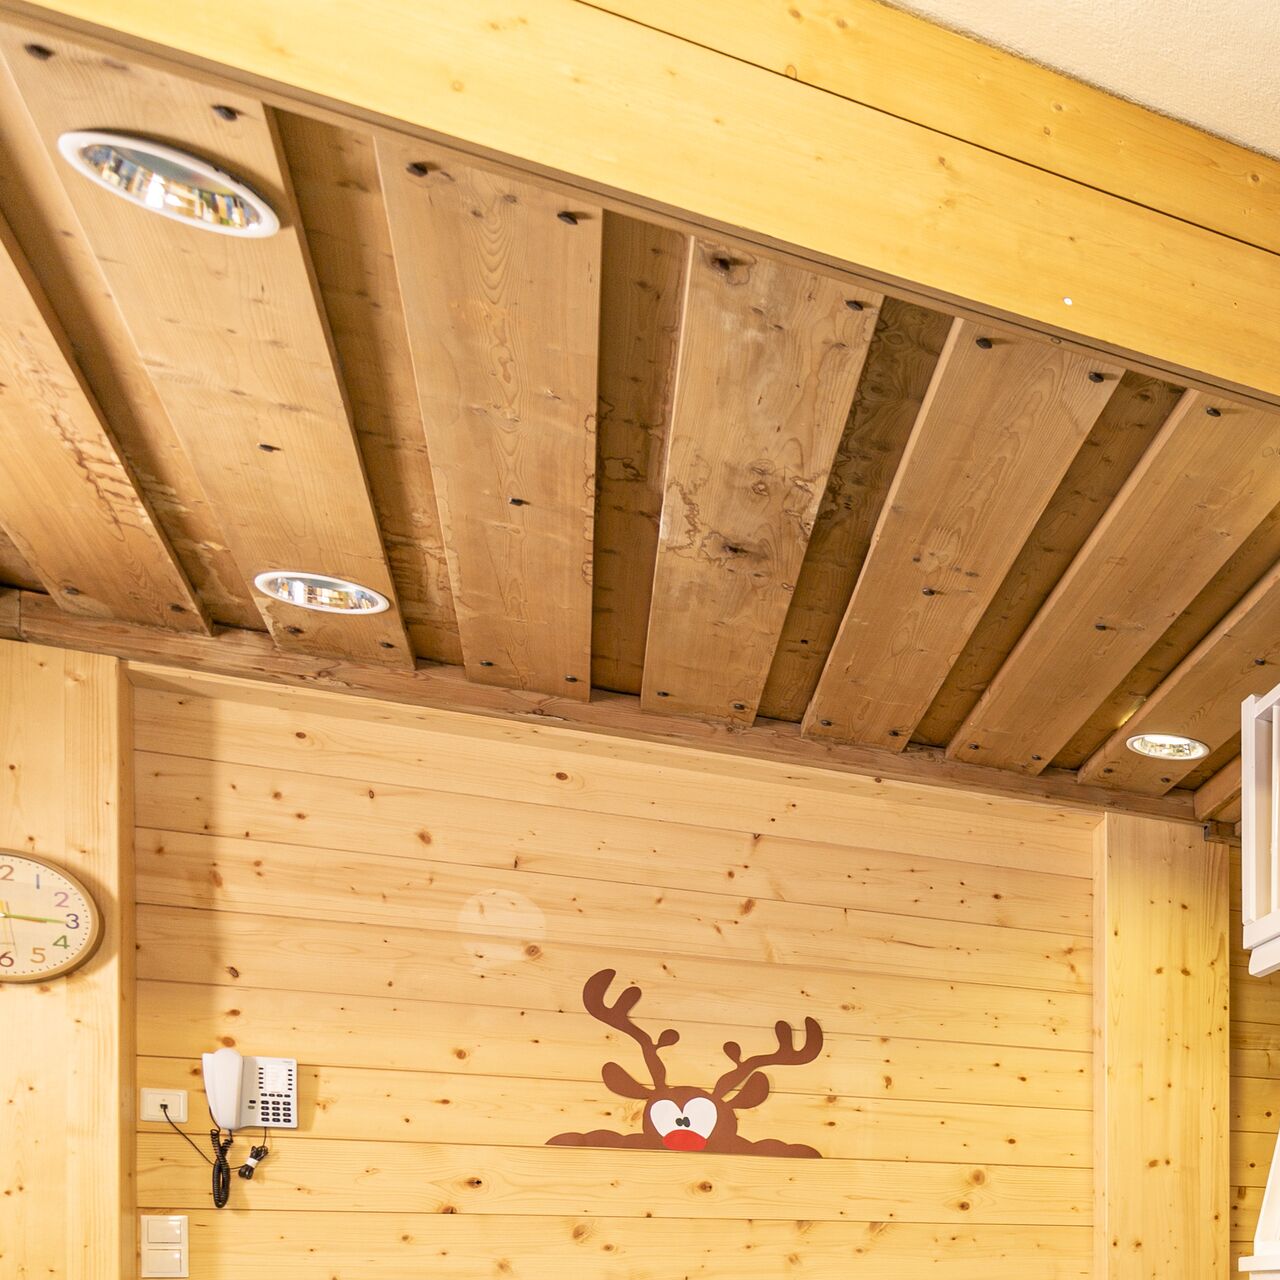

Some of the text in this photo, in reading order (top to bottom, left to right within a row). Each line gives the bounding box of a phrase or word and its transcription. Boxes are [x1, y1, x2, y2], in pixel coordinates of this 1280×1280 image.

[0, 864, 14, 882] 2
[36, 873, 40, 890] 1
[54, 891, 69, 908] 2
[65, 913, 80, 930] 3
[52, 934, 70, 950] 4
[0, 951, 14, 968] 6
[30, 947, 46, 964] 5
